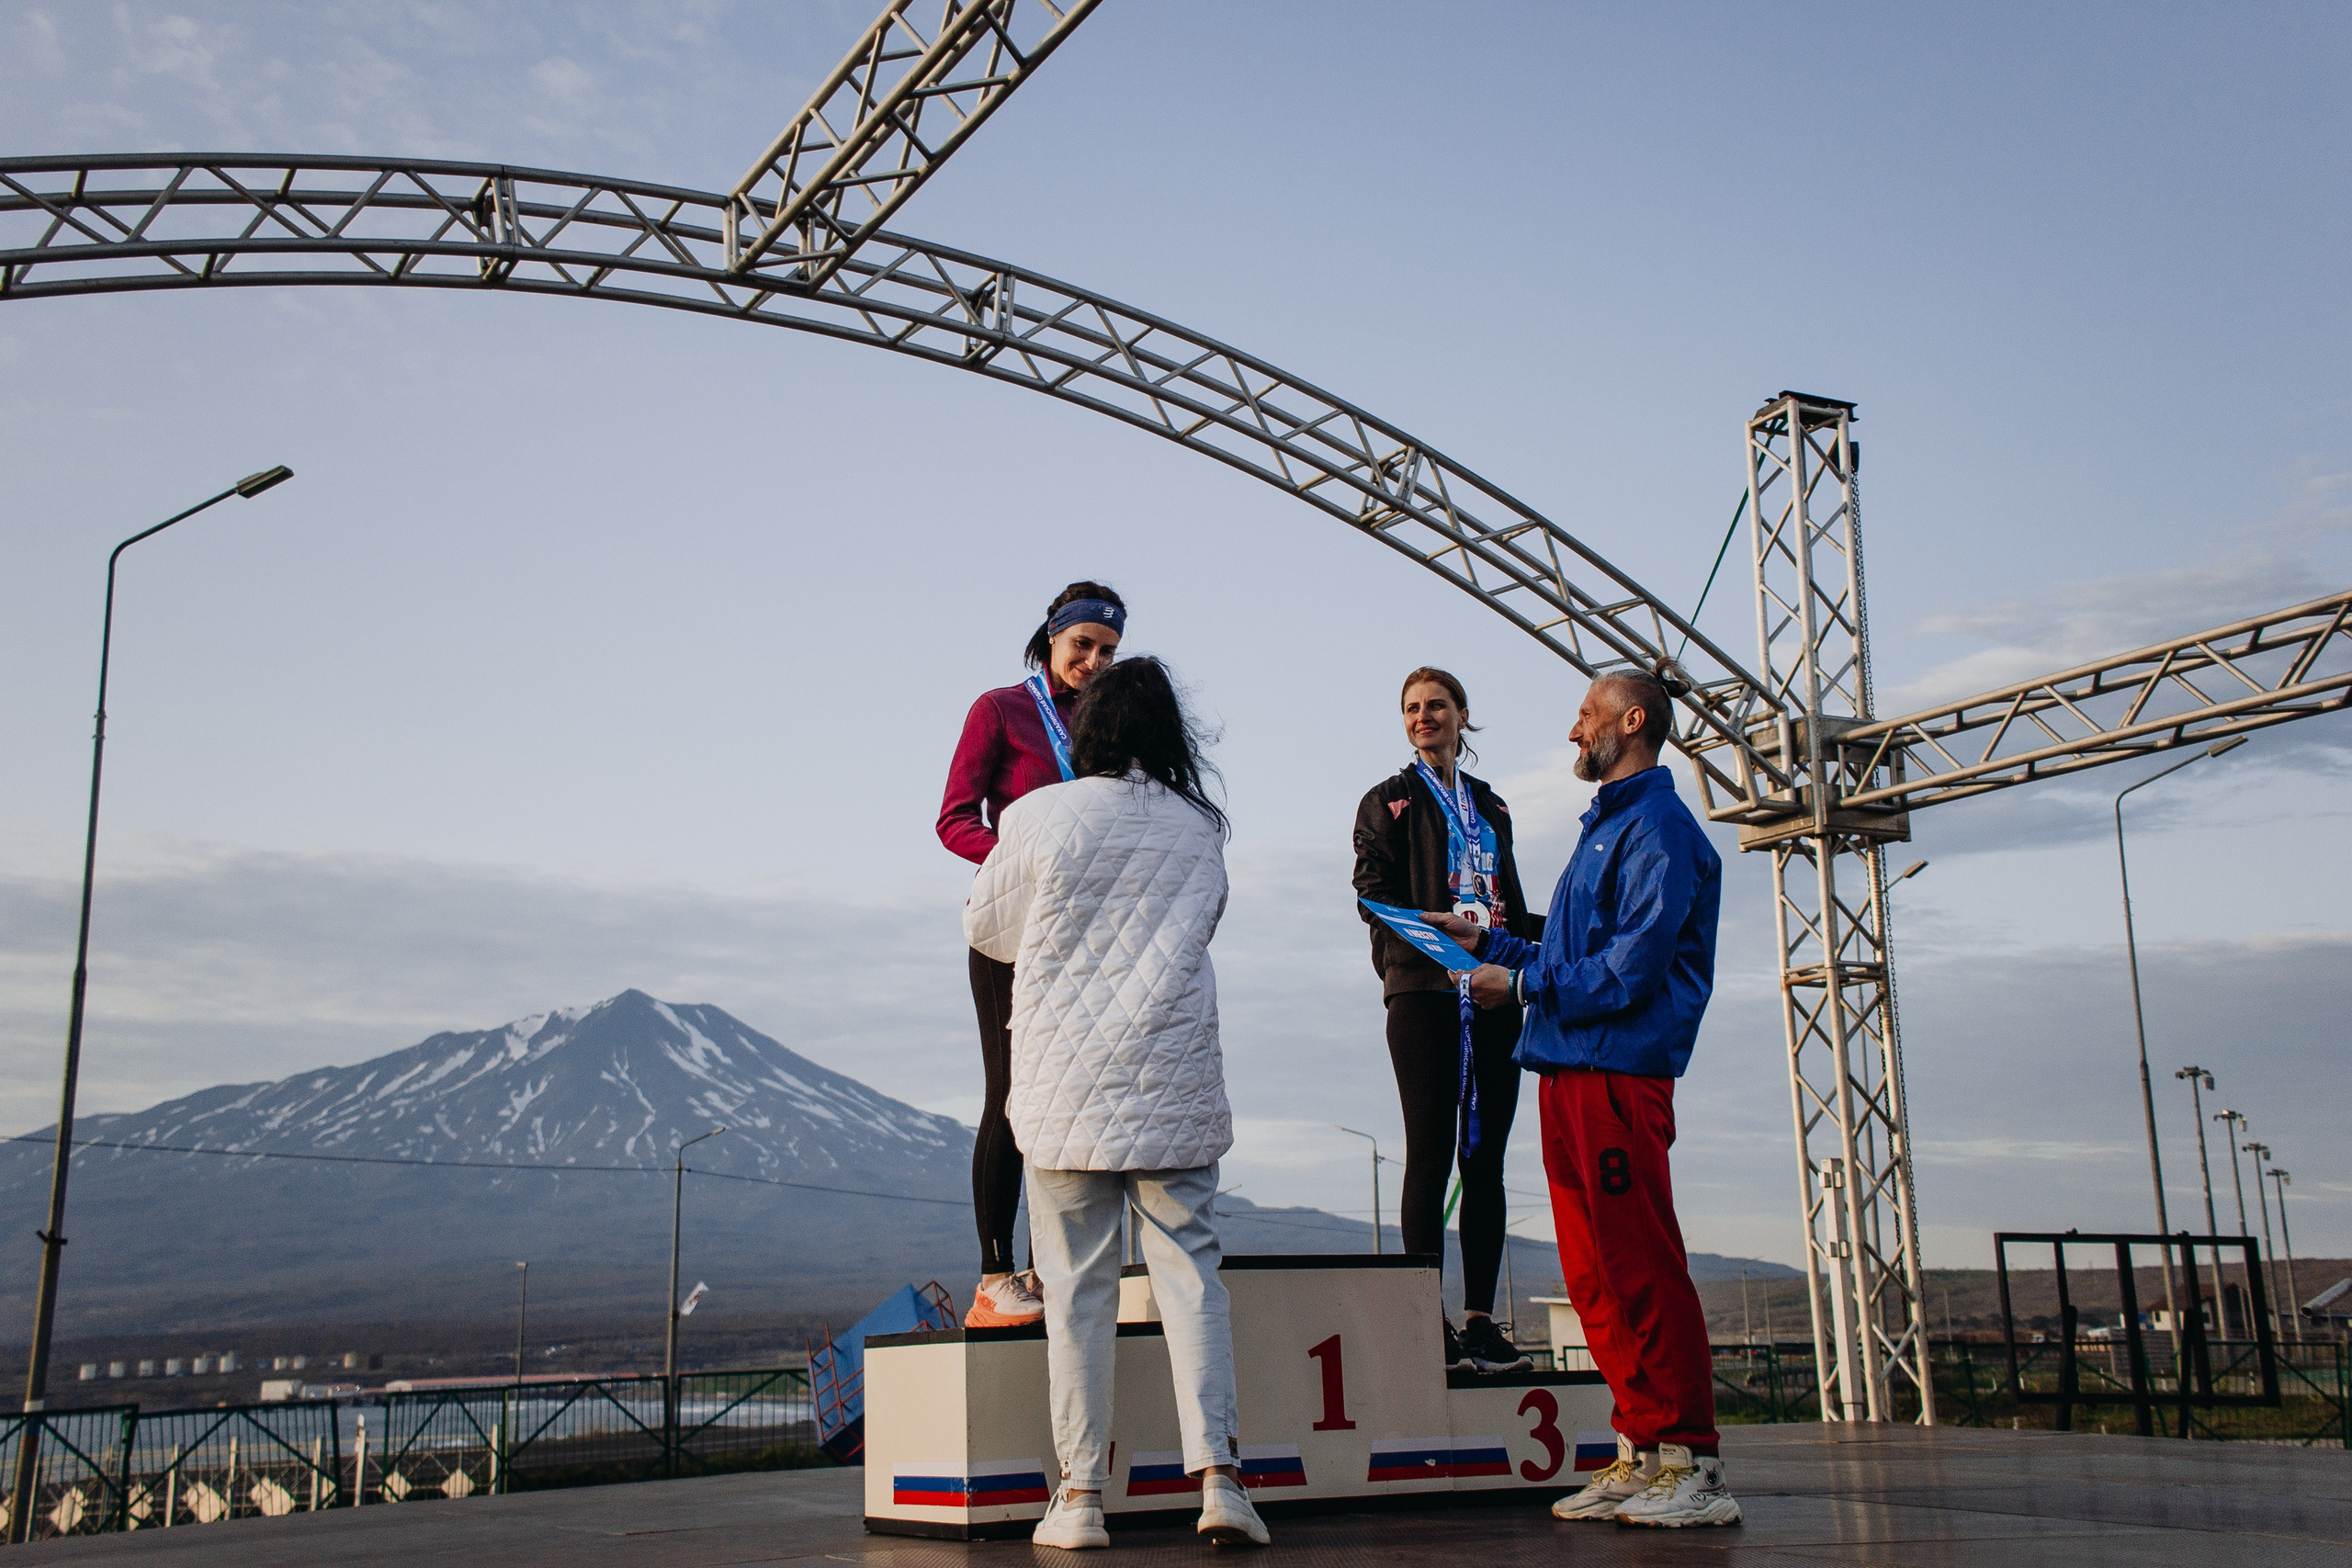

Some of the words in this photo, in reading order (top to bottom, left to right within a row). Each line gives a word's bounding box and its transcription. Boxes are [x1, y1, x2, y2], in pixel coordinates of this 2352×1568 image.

[1027, 679, 1043, 700] ОБЛАСТЬ
[1040, 700, 1067, 739] САХАЛИНСКАЯ
[1423, 768, 1449, 798] САХАЛИНСКАЯ
[1599, 1147, 1632, 1196] 8
[1307, 1334, 1356, 1431] 1
[1517, 1388, 1566, 1482] 3
